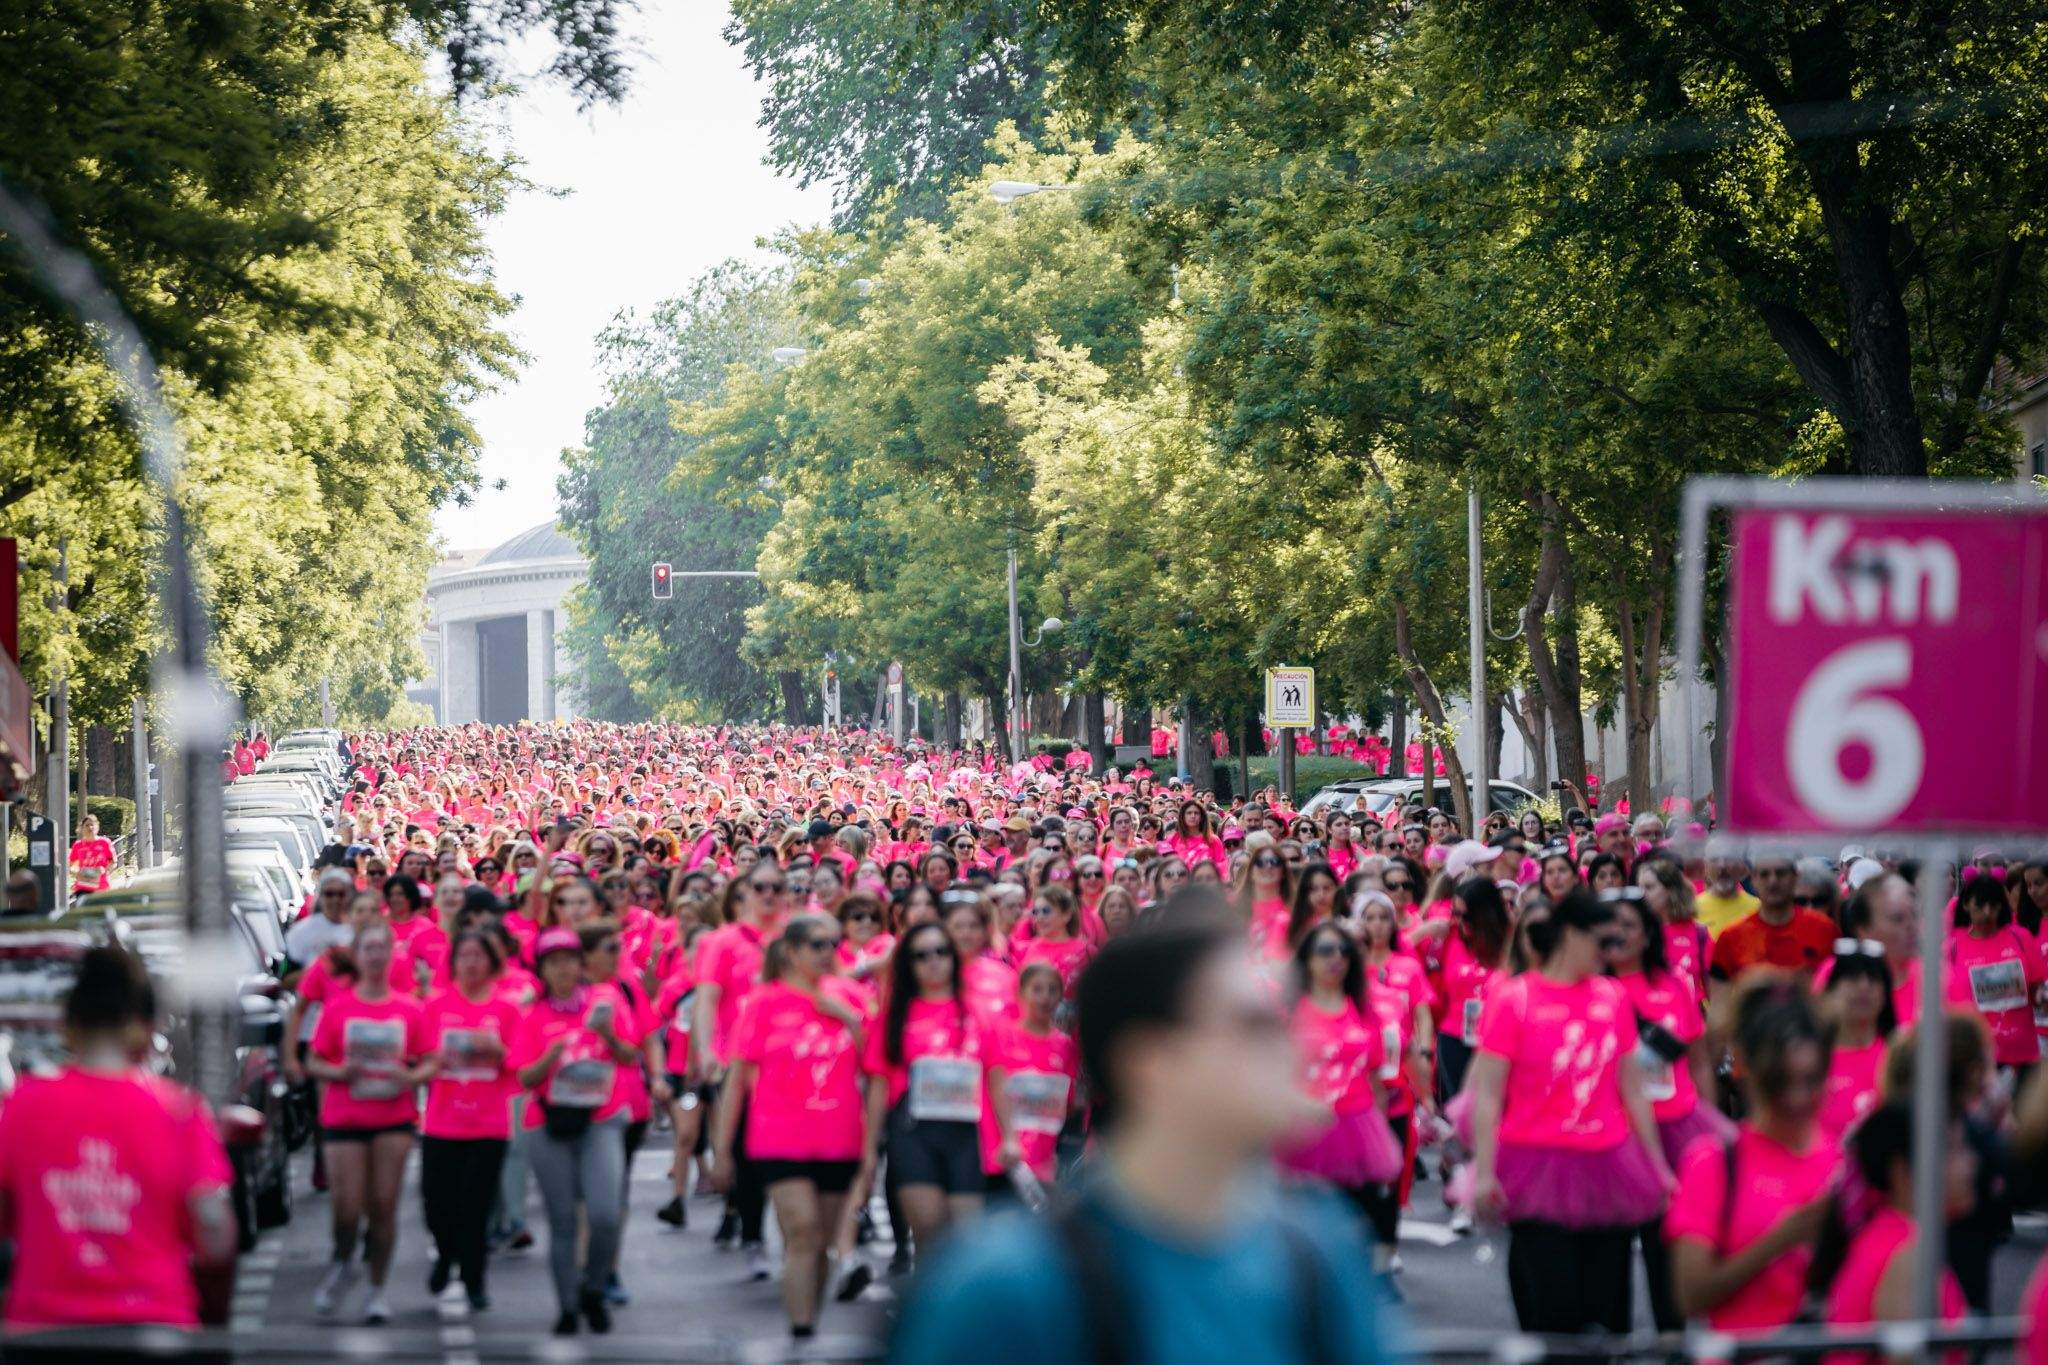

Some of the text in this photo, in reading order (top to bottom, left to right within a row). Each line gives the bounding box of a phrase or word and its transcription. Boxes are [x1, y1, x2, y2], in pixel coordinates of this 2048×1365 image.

[1769, 514, 1960, 626] Km
[1787, 636, 1926, 828] 6
[31, 816, 44, 832] P
